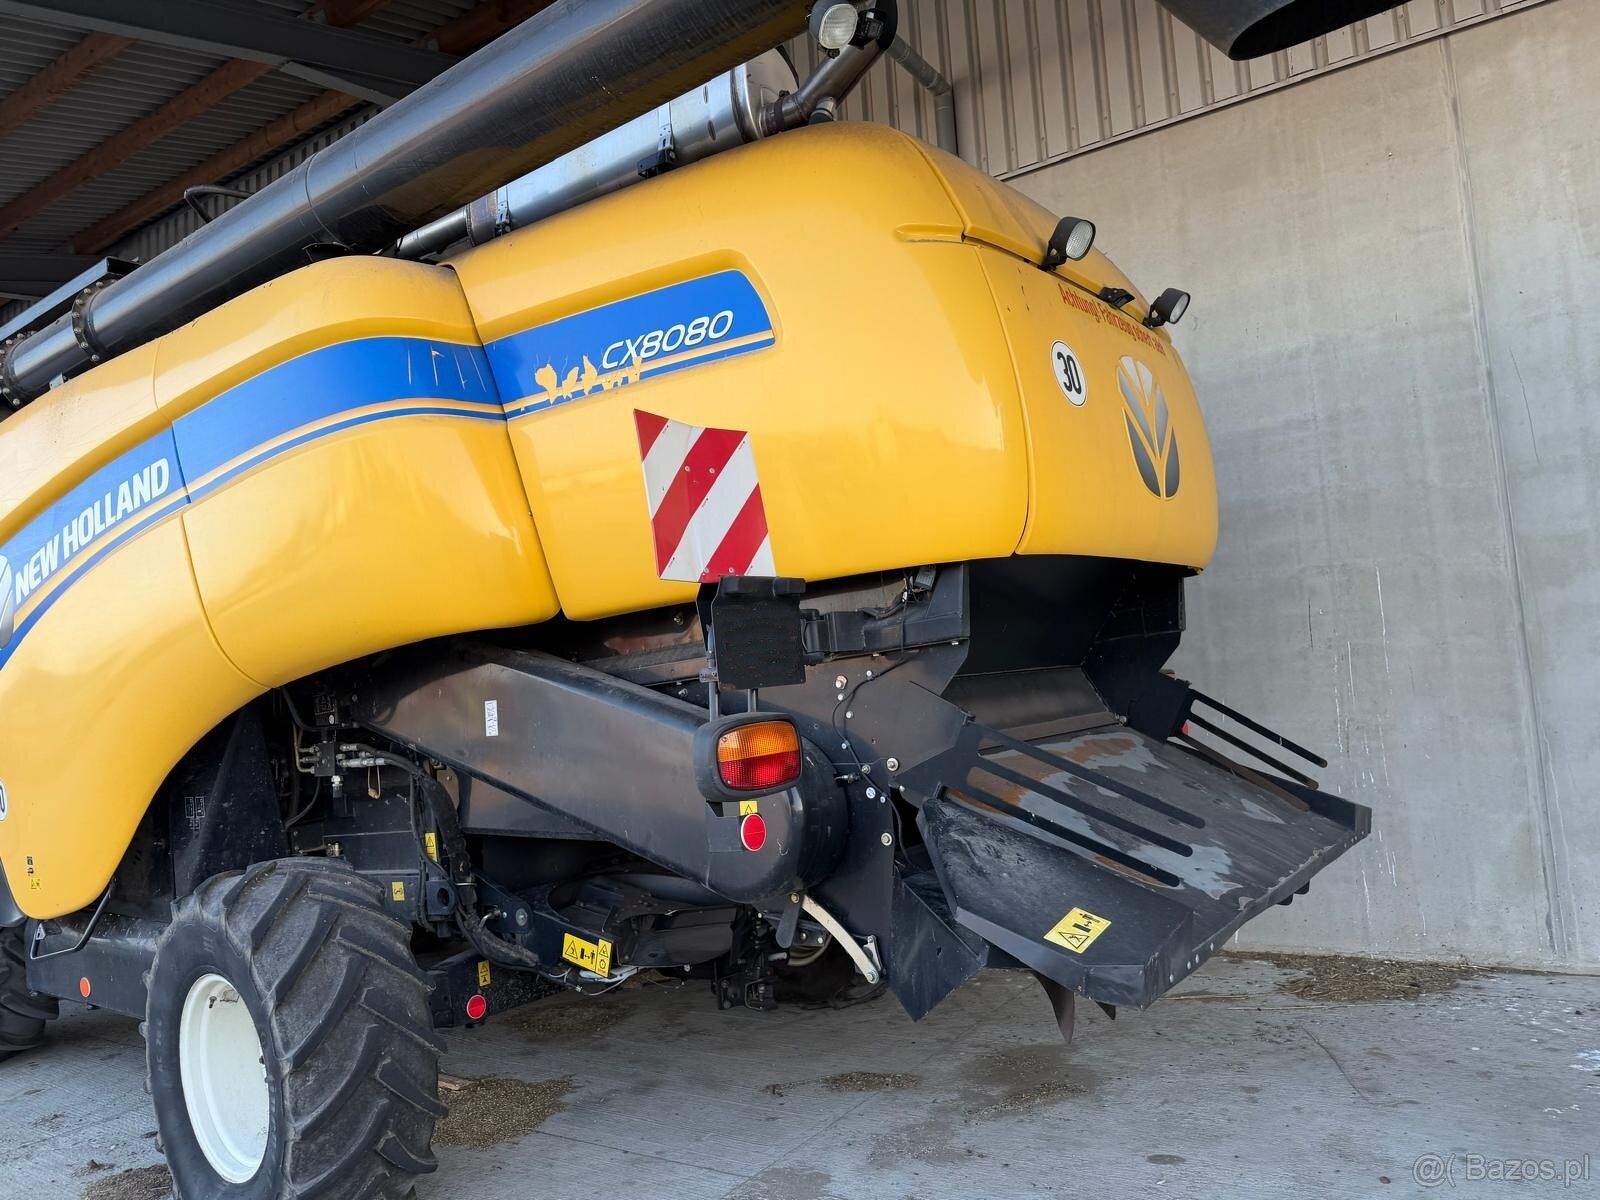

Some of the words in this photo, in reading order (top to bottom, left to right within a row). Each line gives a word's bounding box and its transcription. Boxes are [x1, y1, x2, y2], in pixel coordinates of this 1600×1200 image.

[602, 310, 734, 369] CX8080
[1057, 352, 1082, 394] 30
[15, 533, 60, 605] NEW
[63, 458, 169, 561] HOLLAND
